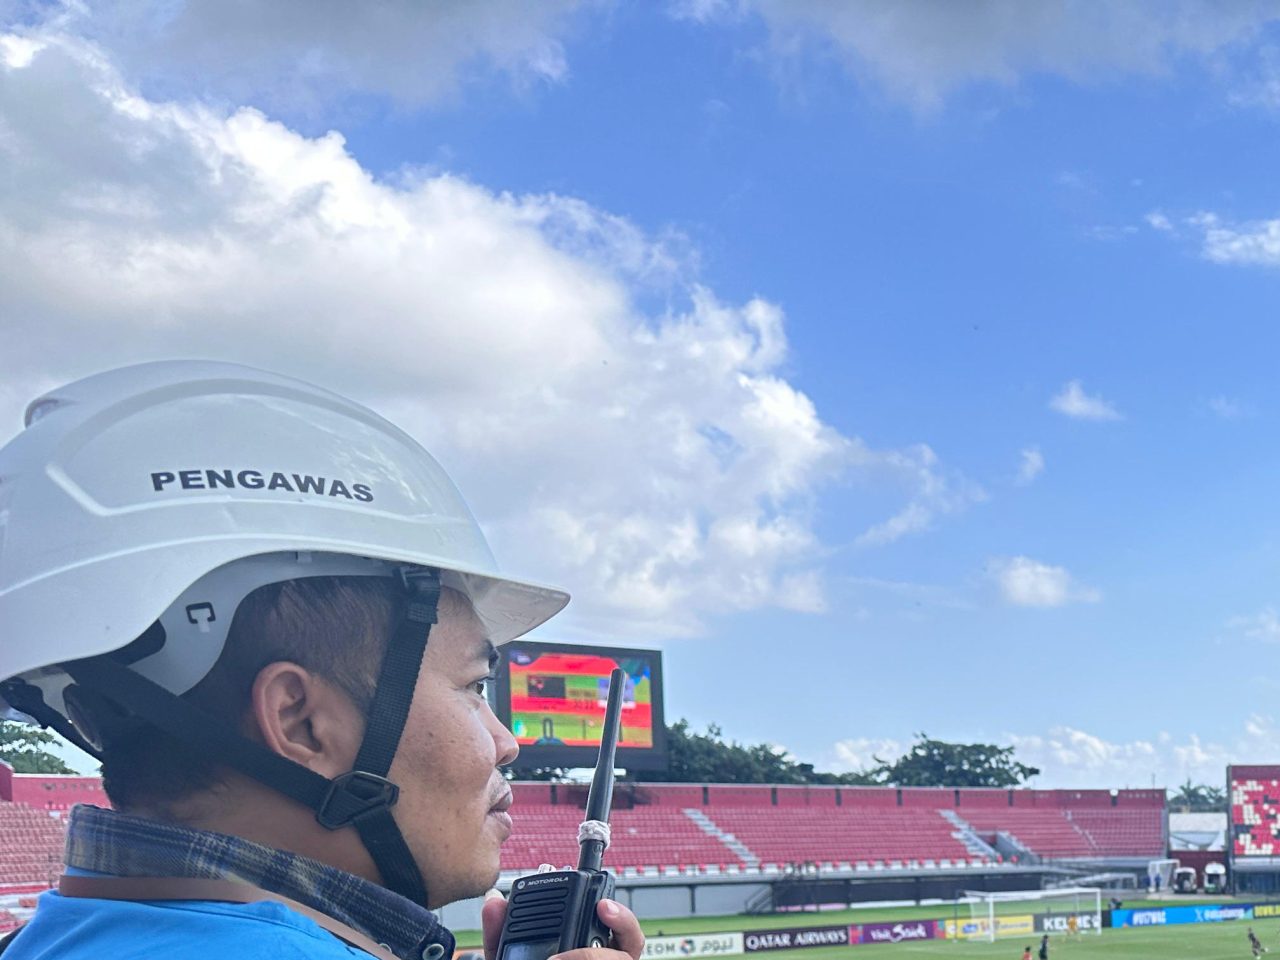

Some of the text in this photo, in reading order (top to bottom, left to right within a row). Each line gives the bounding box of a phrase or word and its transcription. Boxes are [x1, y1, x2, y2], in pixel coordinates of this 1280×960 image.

[150, 469, 374, 502] PENGAWAS
[527, 876, 569, 886] MOTOROLA
[745, 929, 847, 950] QATAR AIRWAYS
[641, 943, 676, 956] EOM
